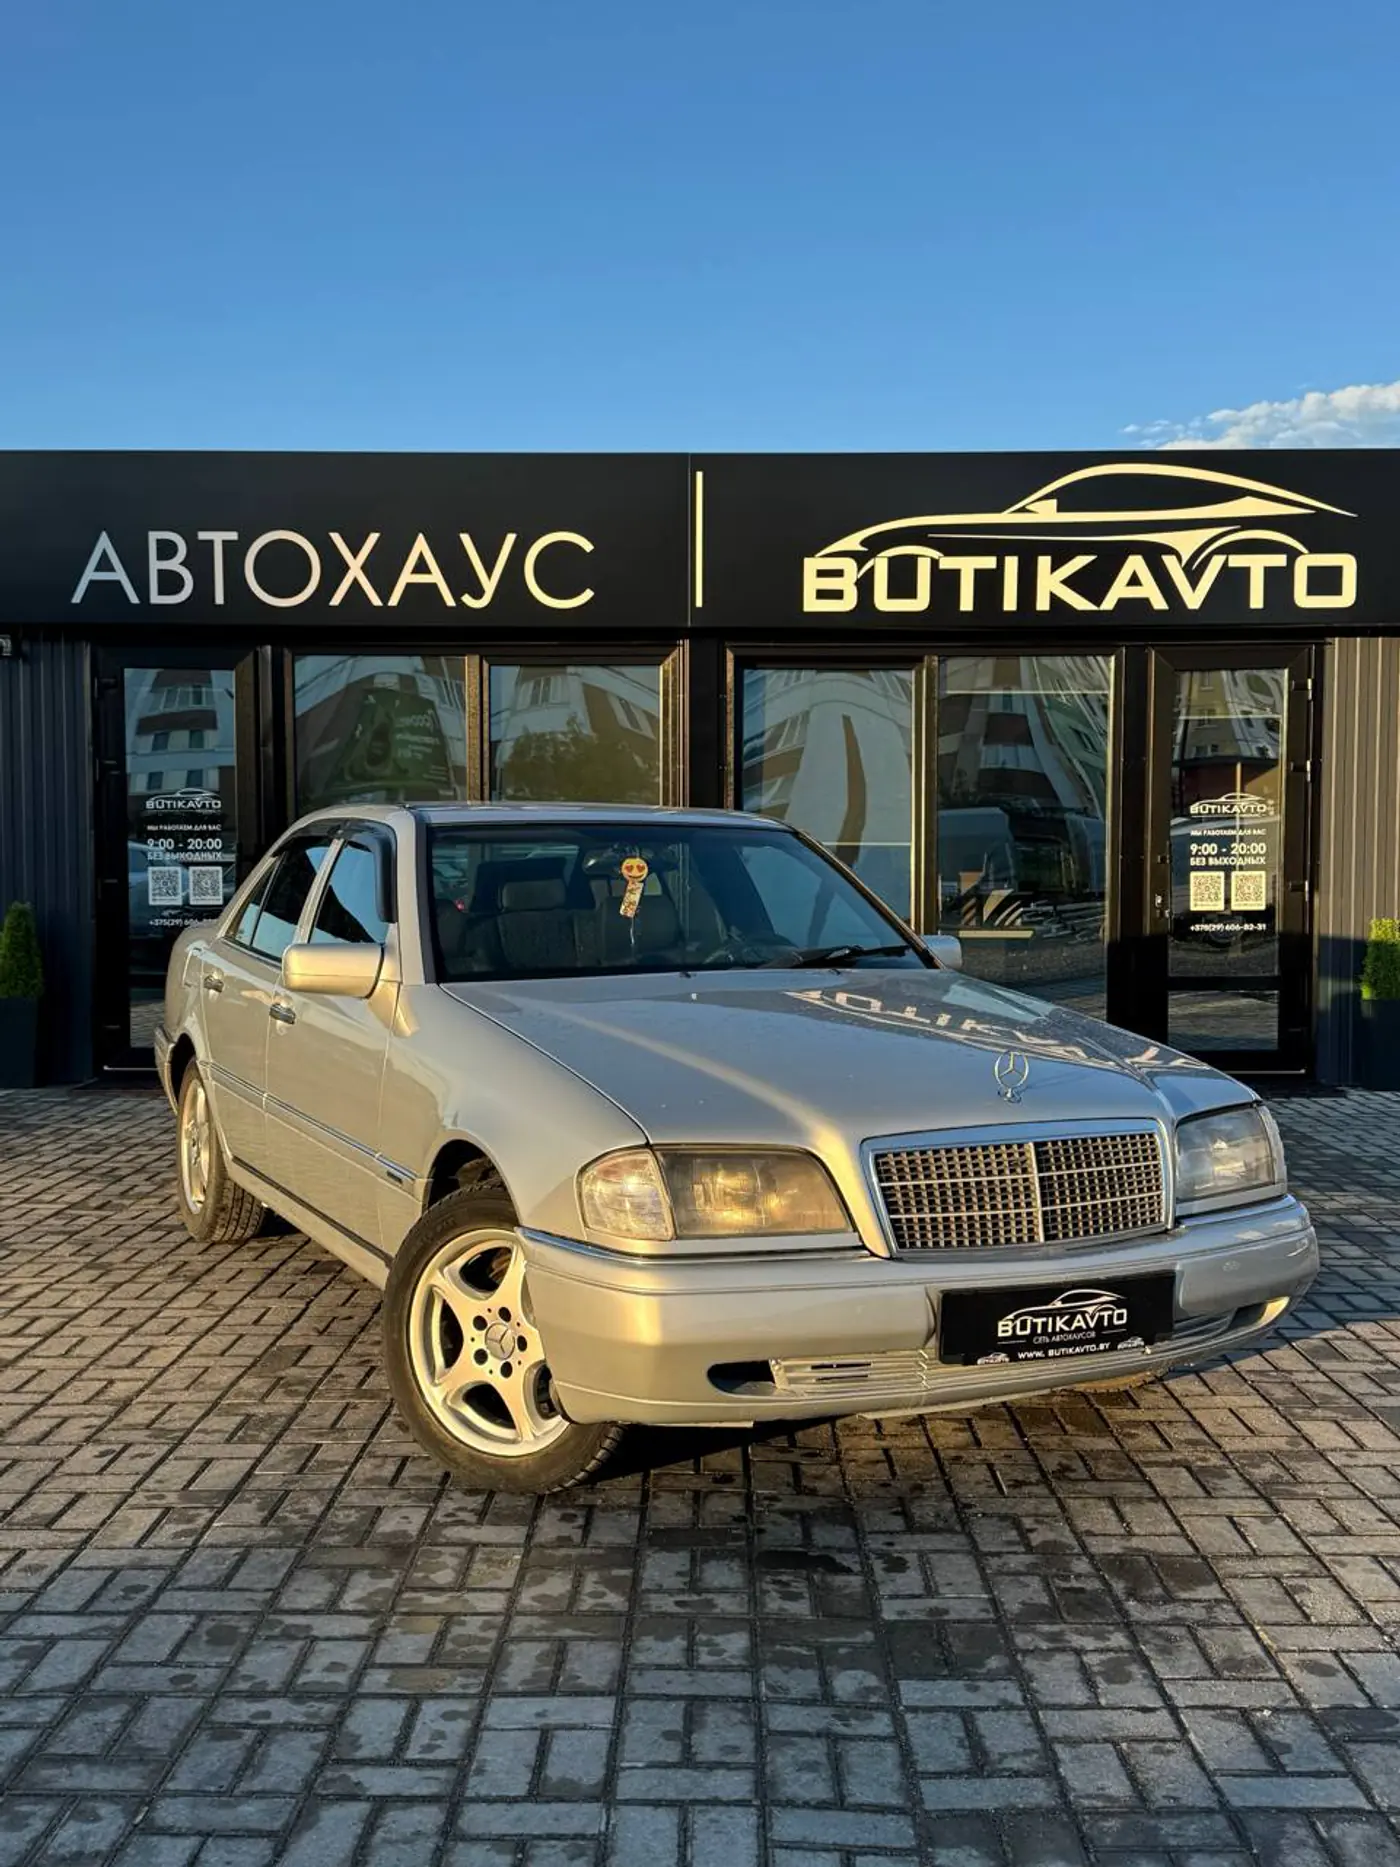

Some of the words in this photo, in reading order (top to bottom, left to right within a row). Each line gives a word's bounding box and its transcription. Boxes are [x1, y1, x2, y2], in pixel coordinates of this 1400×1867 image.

[71, 529, 595, 609] АВТОХАУС
[803, 551, 1358, 613] BUTIKAVTO
[145, 799, 222, 810] BUTIKAVTO
[1189, 803, 1267, 814] BUTIKAVTO
[147, 838, 175, 850] 9:00
[187, 838, 223, 850] 20:00
[1190, 843, 1217, 855] 9:00
[1231, 843, 1267, 855] 20:00
[147, 851, 164, 860] БЕЗ
[165, 851, 222, 861] ВЫХОДНЫХ
[1190, 856, 1206, 866] БЕЗ
[1208, 856, 1267, 866] ВЫХОДНЫХ
[997, 1307, 1128, 1338] BUTIKAVTO
[1048, 1341, 1111, 1357] BUTIKAVTO.BY
